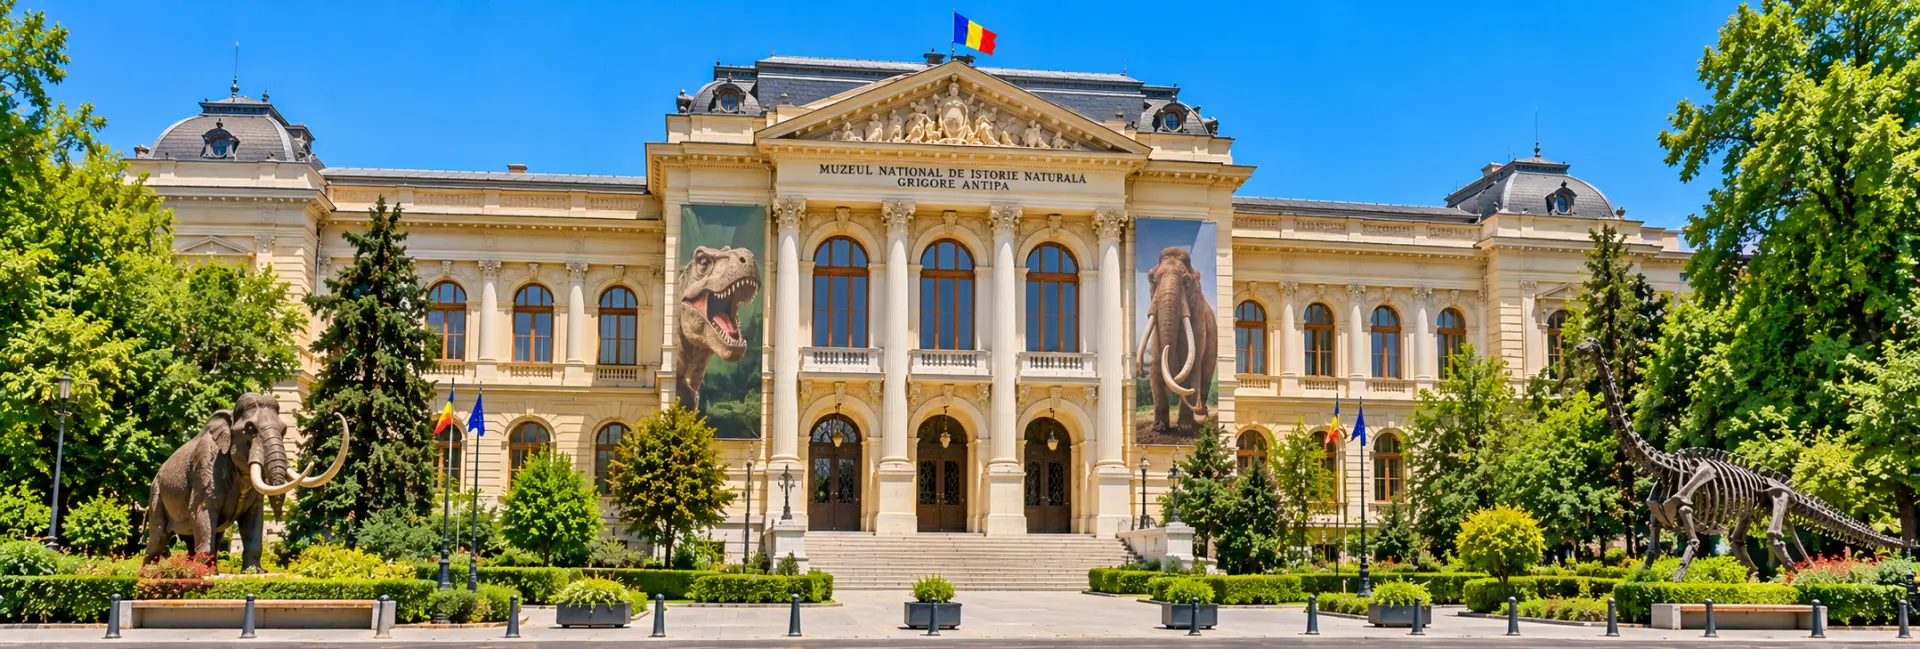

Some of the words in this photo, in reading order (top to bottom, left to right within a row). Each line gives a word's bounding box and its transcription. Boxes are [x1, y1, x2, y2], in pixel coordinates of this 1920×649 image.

[819, 163, 873, 175] MUZEUL
[878, 165, 943, 178] NATIONAL
[948, 169, 965, 179] DE
[970, 169, 1019, 181] ISTORIE
[897, 177, 955, 189] GRIGORE
[962, 180, 1010, 191] ANTIPA
